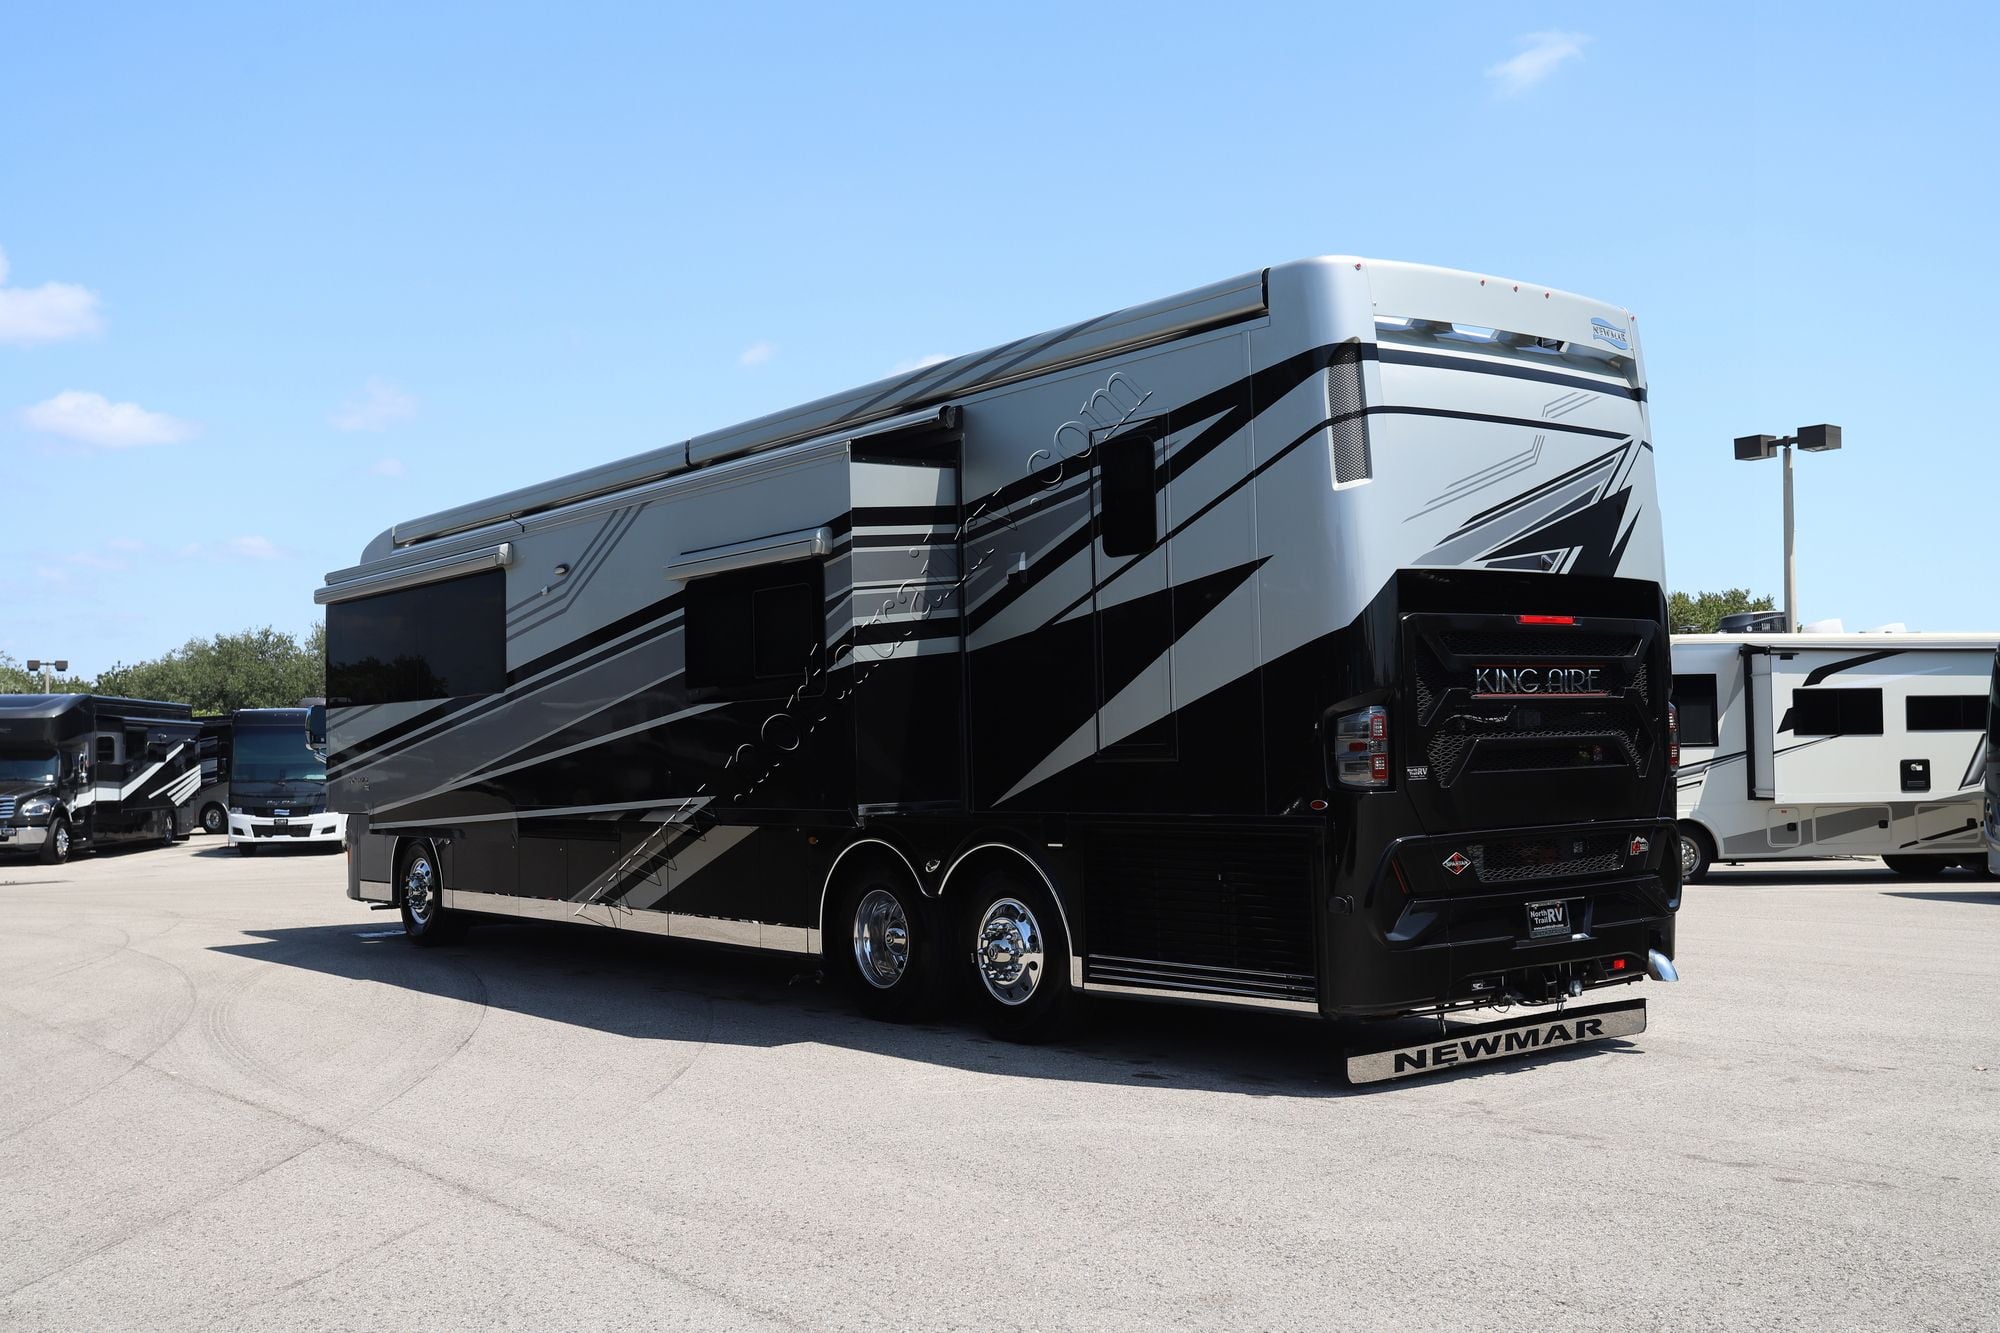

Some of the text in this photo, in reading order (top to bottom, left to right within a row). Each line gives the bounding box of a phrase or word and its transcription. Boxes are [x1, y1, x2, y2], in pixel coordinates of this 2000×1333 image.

[1476, 668, 1600, 693] KING AIRE
[1530, 909, 1547, 917] North
[1547, 908, 1562, 922] RV
[1394, 1018, 1604, 1073] NEWMAR
